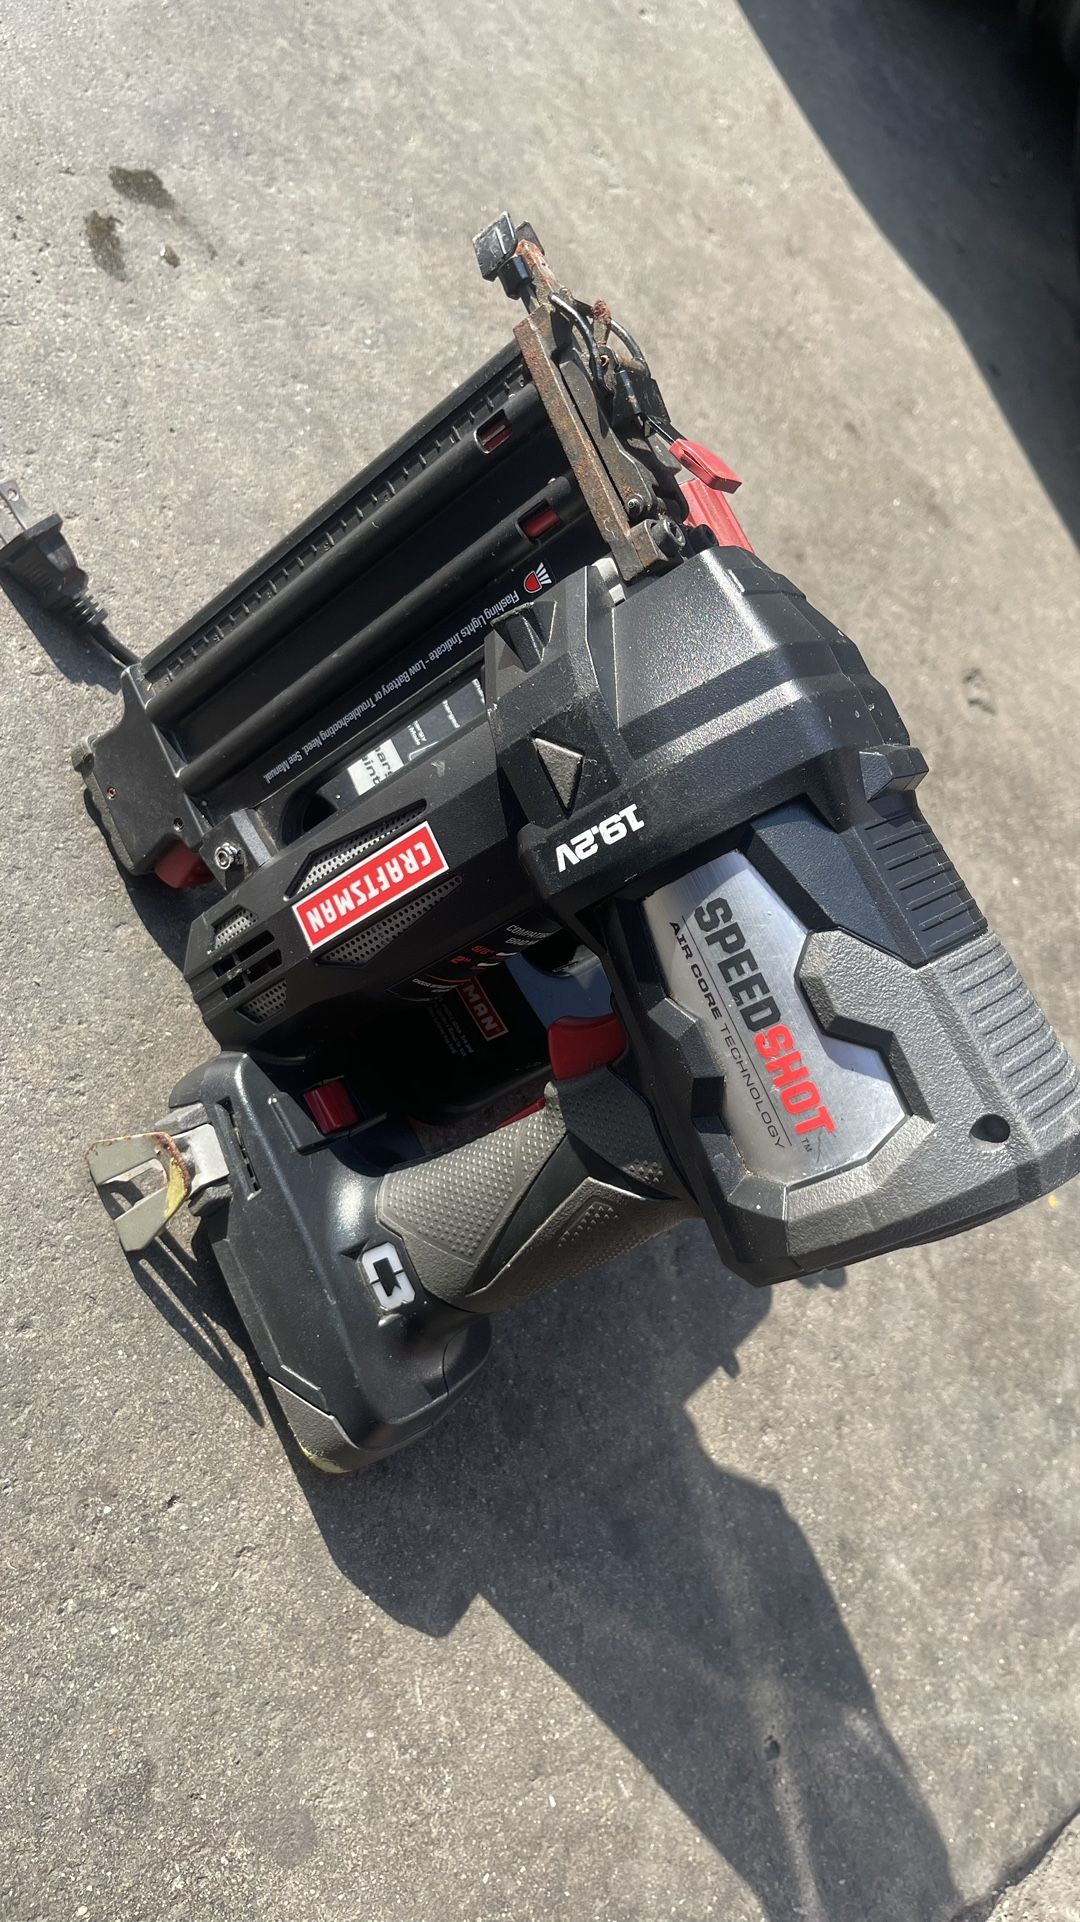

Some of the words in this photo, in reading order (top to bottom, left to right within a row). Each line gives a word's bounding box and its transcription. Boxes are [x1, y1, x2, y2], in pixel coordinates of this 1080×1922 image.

[483, 590, 520, 619] Flashing
[460, 614, 487, 638] Lights
[428, 632, 463, 661] Indicate
[408, 659, 427, 676] Low
[373, 690, 383, 702] or
[381, 671, 411, 696] Battery
[319, 697, 377, 741] Troubleshooting
[287, 750, 303, 765] See
[555, 803, 645, 873] 19.2V
[306, 841, 431, 933] CRAFTSMAN
[463, 983, 498, 1032] MAN
[694, 897, 836, 1134] SPEEDSHOT
[668, 921, 693, 959] AIR
[690, 963, 723, 1020] CORE
[720, 1019, 785, 1149] TECHNOLOGY
